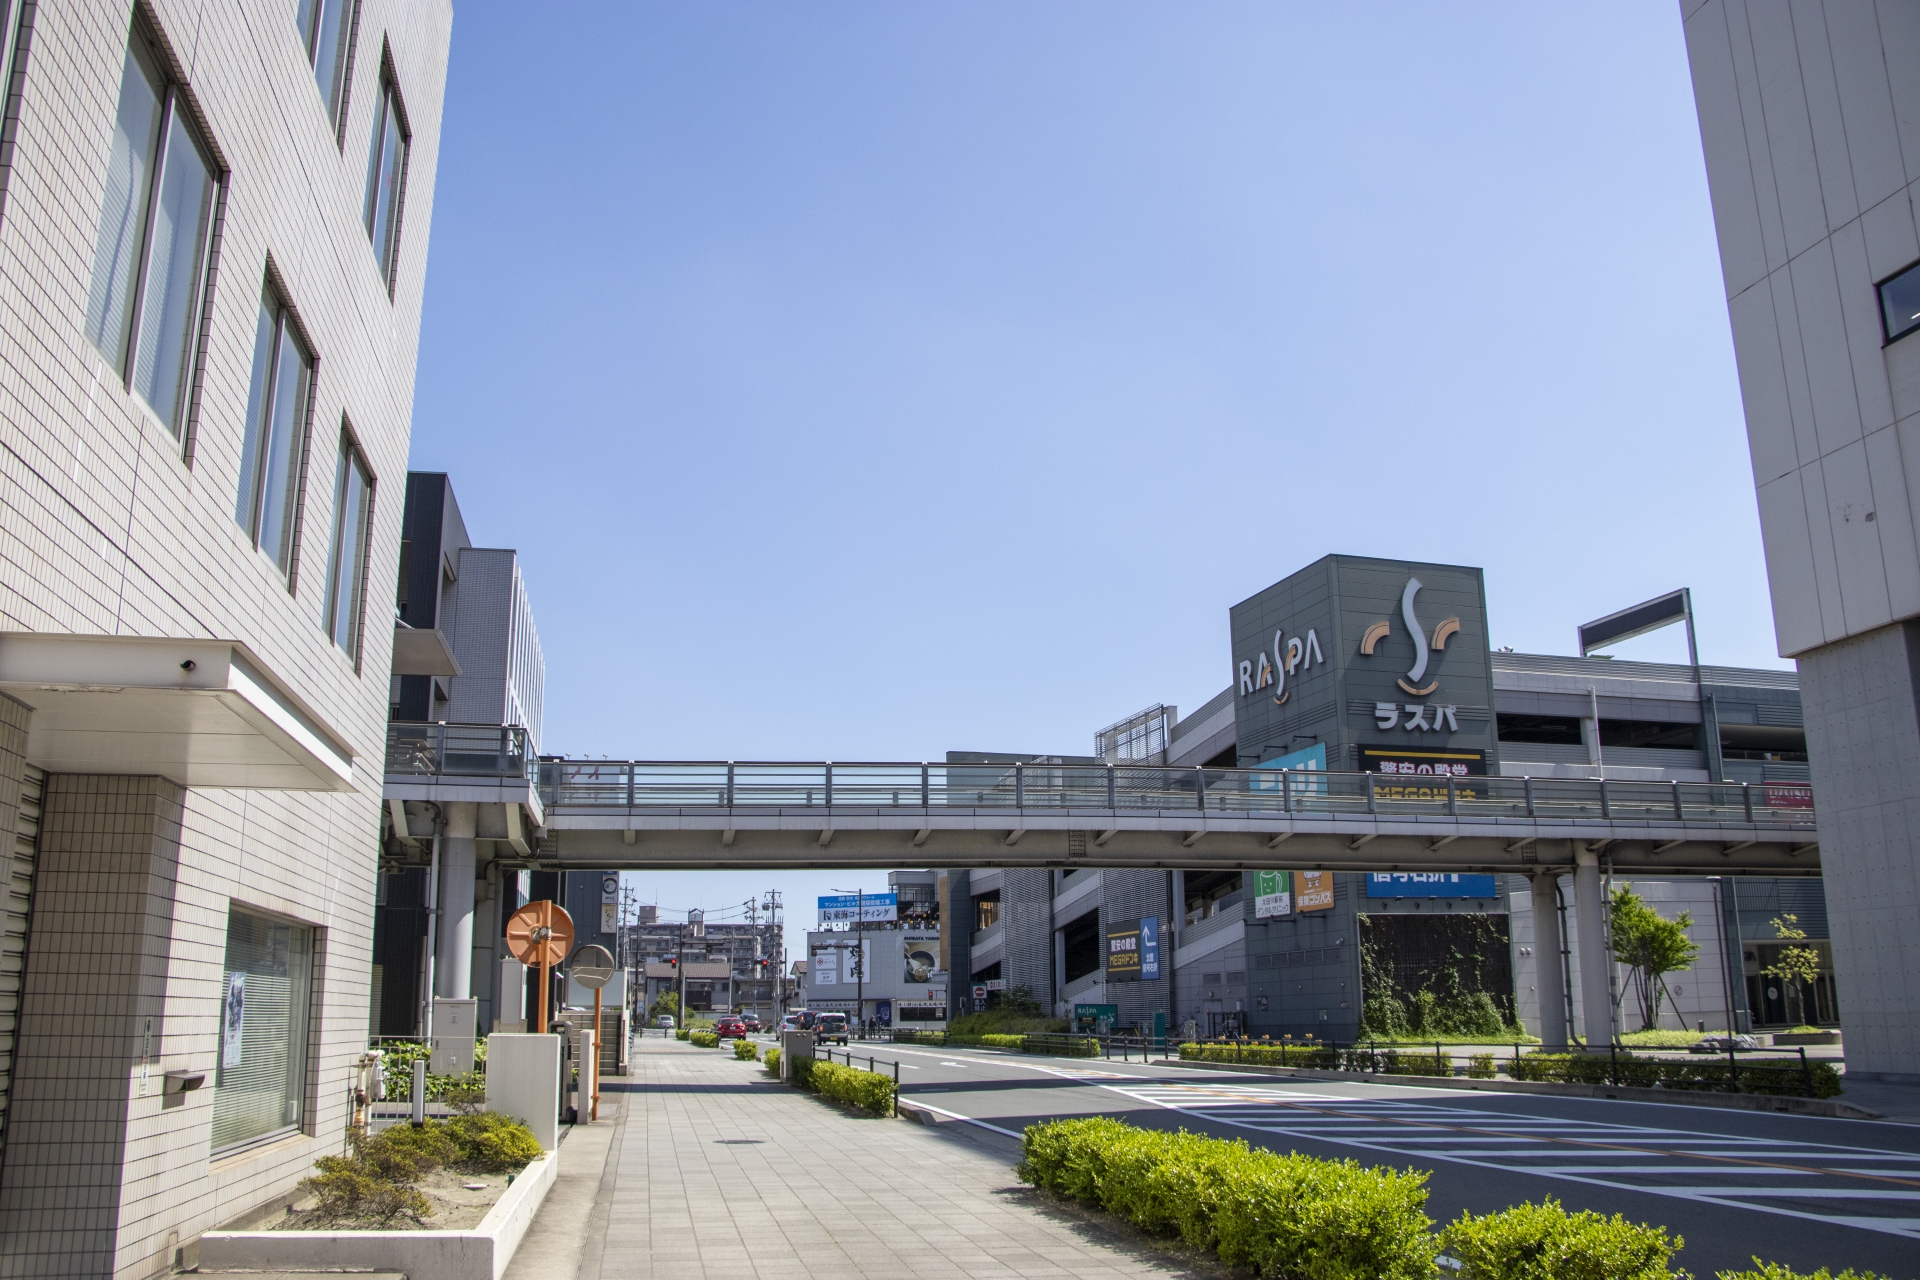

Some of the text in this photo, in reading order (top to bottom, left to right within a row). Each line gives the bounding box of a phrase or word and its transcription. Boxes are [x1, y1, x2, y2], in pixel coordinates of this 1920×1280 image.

[1239, 629, 1325, 696] RASPA
[1375, 702, 1458, 732] ラスパ
[1298, 891, 1332, 907] 保険コンパス
[833, 908, 890, 920] 東海コーティング
[1257, 904, 1289, 916] デンタルクリニック
[1109, 952, 1139, 966] MEGAドンキ
[1077, 1006, 1097, 1015] RASPA
